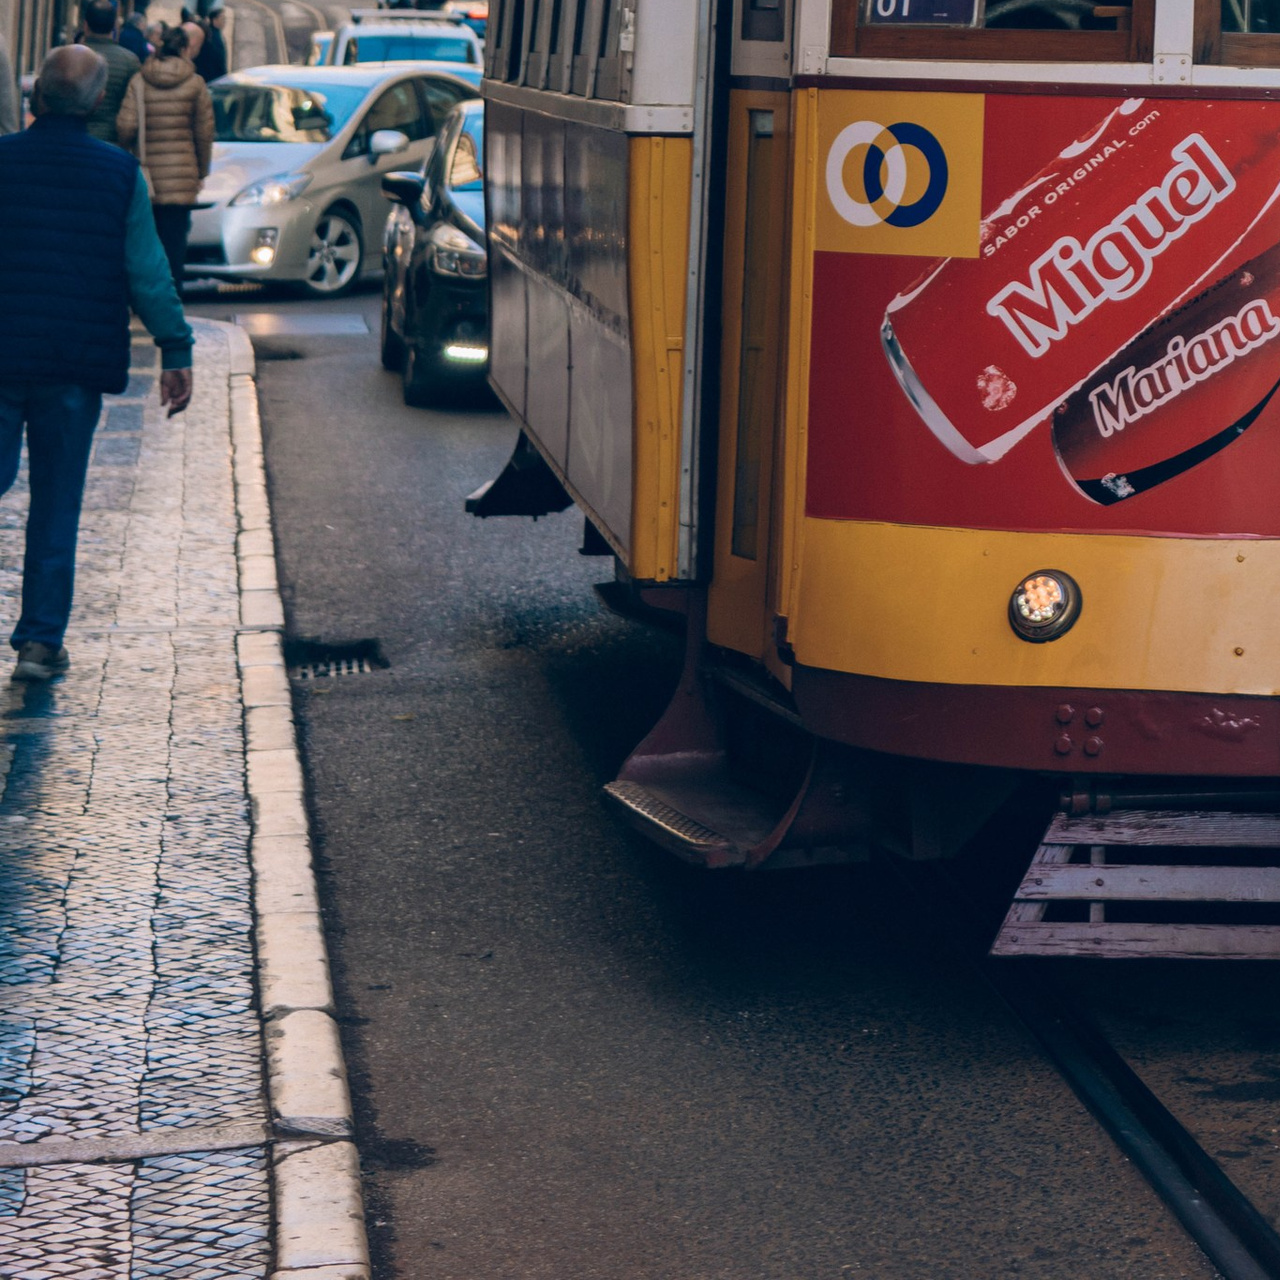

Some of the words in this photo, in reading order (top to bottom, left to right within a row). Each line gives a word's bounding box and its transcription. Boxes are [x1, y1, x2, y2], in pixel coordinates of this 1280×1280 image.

[983, 205, 1042, 257] SABOR
[1044, 139, 1127, 204] ORIGINAL
[1128, 110, 1161, 136] com
[989, 135, 1234, 355] Miguel
[1092, 300, 1280, 436] Mariana
